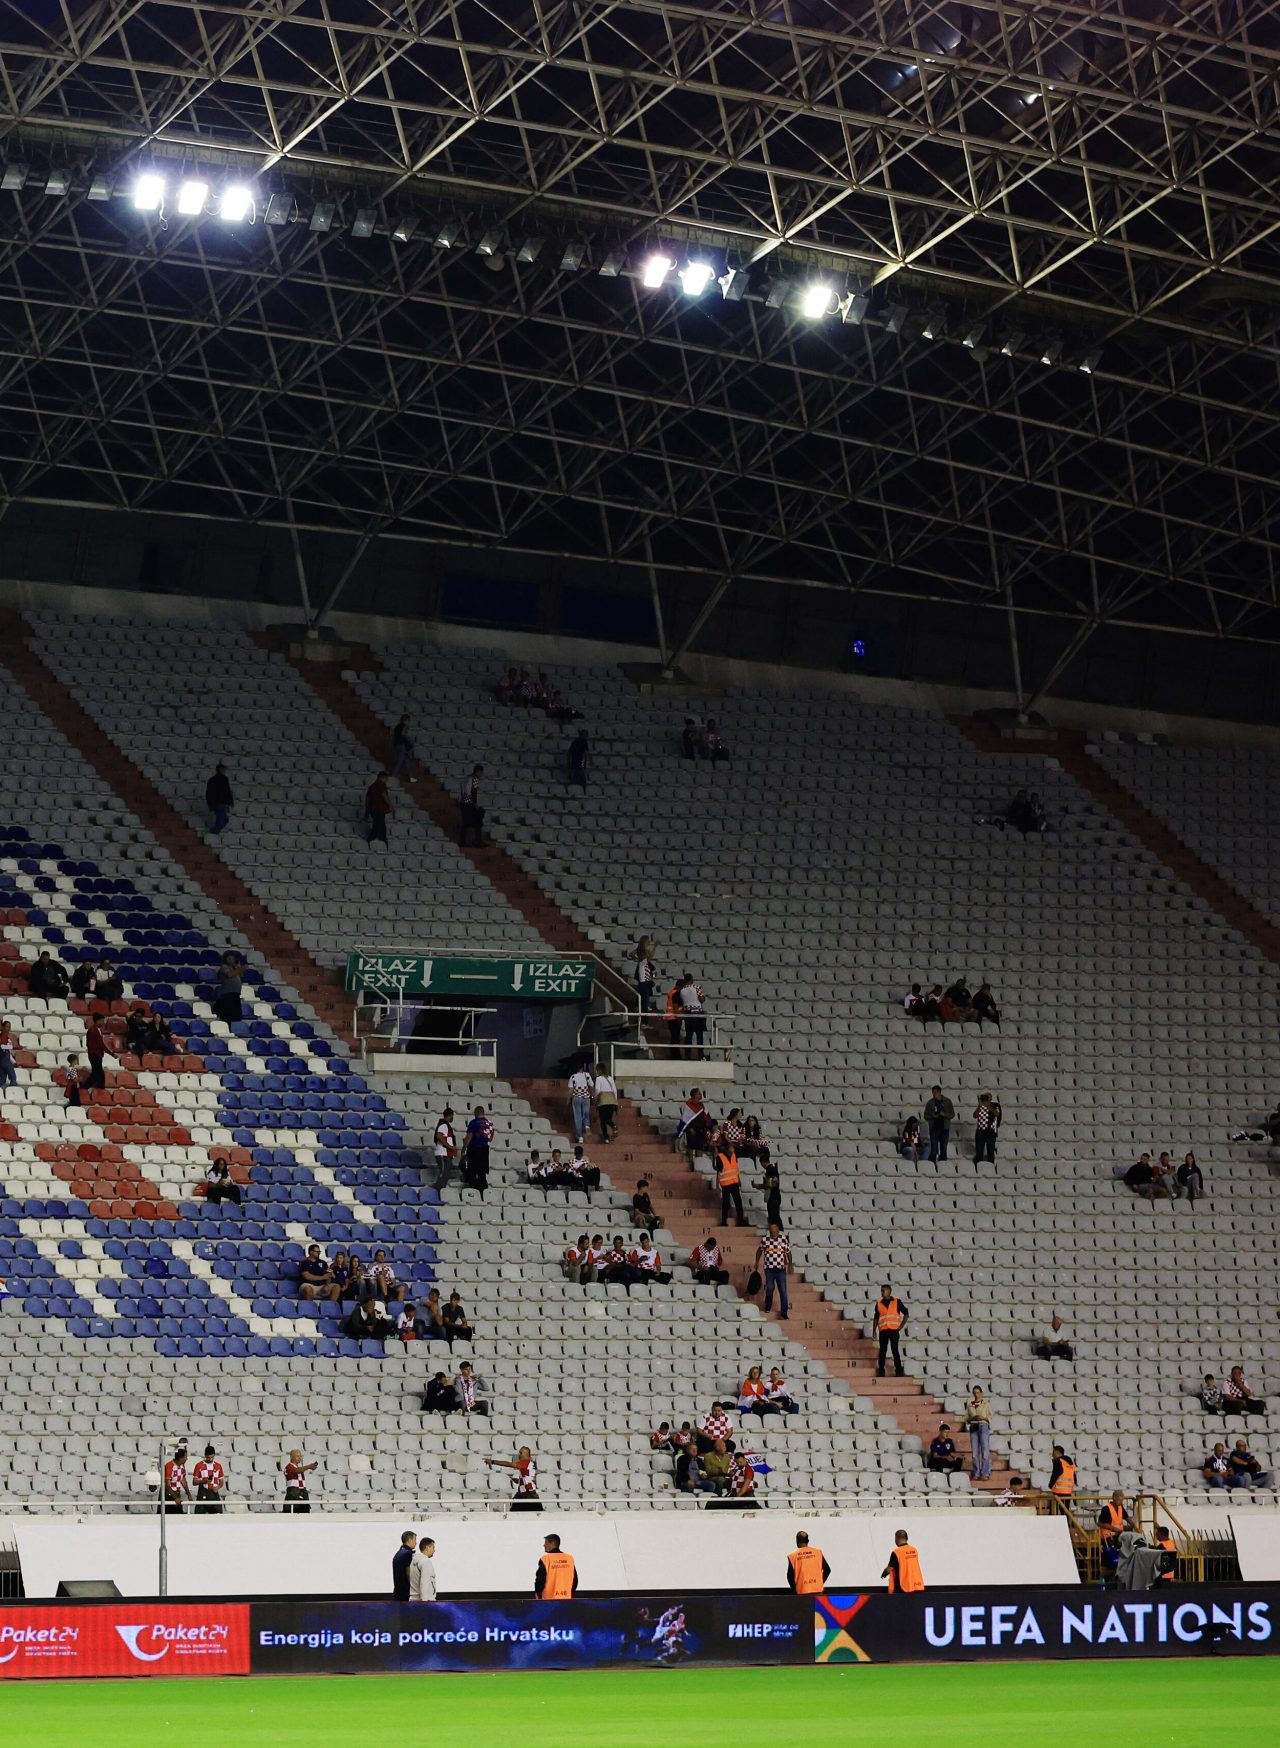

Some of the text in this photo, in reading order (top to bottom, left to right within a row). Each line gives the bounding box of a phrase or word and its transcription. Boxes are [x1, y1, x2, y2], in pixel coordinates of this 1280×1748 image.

[358, 957, 417, 972] IZLAZ
[528, 963, 587, 977] IZLAZ
[363, 974, 409, 988] EXIT
[534, 979, 579, 993] EXIT
[743, 1623, 772, 1638] HEP
[924, 1601, 1272, 1647] UEFA NATIONS
[260, 1627, 575, 1648] Energija koja pokreće Hrvatsku
